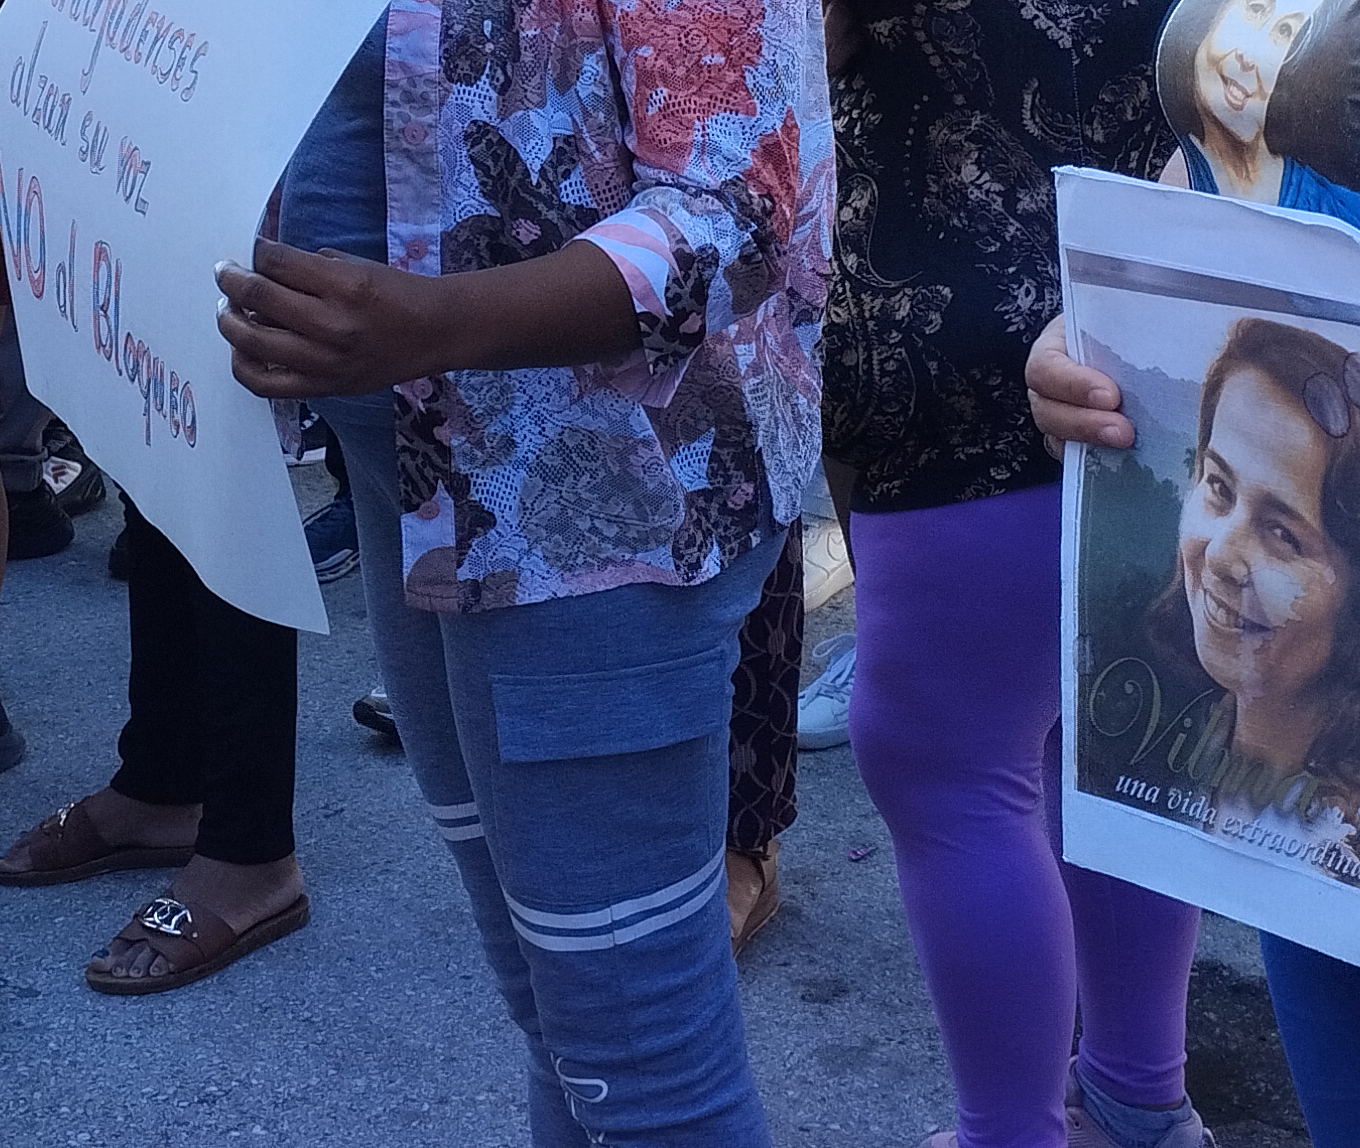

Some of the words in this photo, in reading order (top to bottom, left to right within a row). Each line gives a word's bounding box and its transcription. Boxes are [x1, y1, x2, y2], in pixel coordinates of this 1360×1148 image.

[10, 20, 72, 146] alzan
[78, 110, 109, 174] su
[116, 135, 152, 217] voz
[55, 218, 79, 332] al
[92, 239, 197, 449] Bloqueo
[1090, 656, 1324, 821] Vilma
[1115, 774, 1160, 804] una
[1167, 787, 1219, 825] vida
